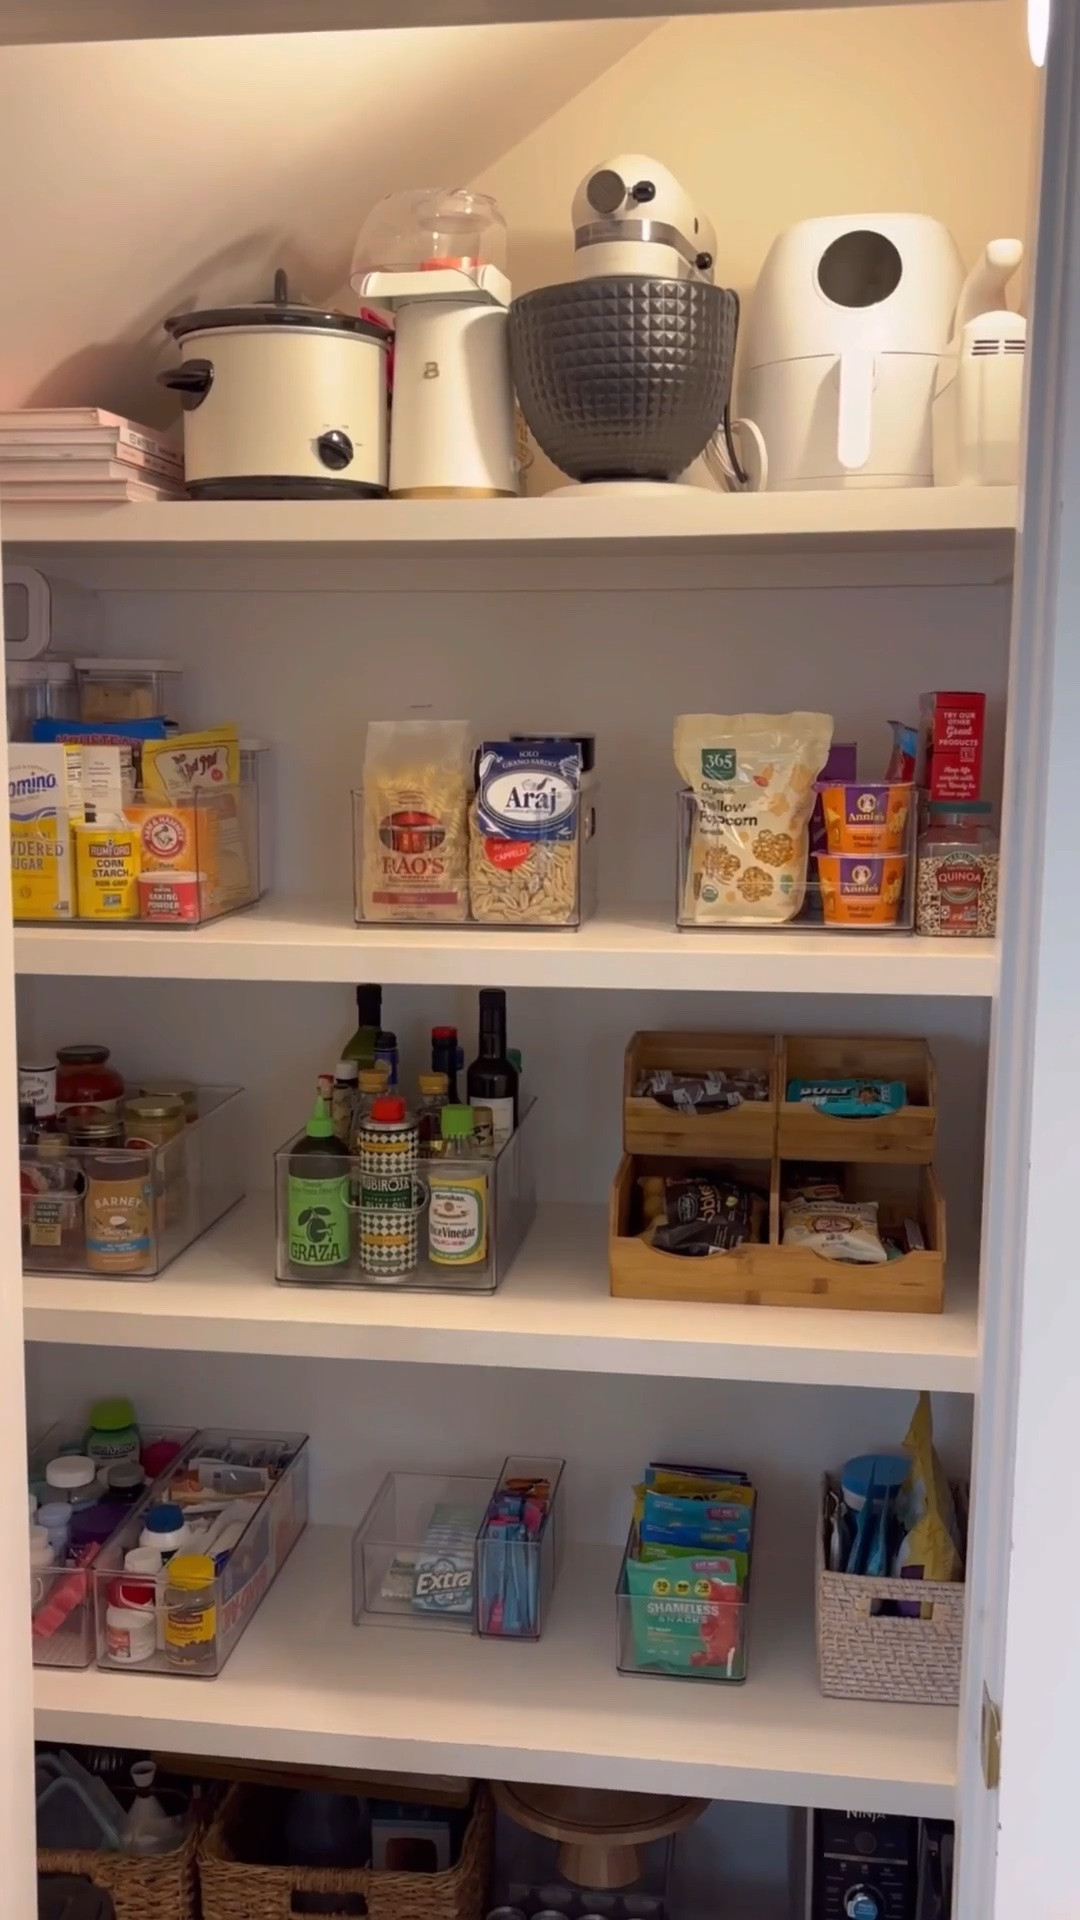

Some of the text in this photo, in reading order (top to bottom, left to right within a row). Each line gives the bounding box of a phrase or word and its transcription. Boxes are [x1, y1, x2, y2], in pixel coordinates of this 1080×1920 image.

[518, 750, 540, 758] SOLO
[705, 753, 733, 769] 365
[502, 758, 530, 769] GRANO
[8, 771, 57, 798] omino
[701, 782, 736, 796] Organic
[505, 786, 557, 816] Araj
[700, 799, 747, 813] Yellow
[699, 810, 758, 827] Popcorn
[11, 840, 64, 857] DERED
[12, 857, 45, 871] UGAR
[96, 859, 124, 868] CORN
[382, 856, 445, 875] RAO'S
[92, 869, 130, 878] STARCH
[938, 871, 982, 883] QUINOA
[94, 1196, 143, 1209] BARNEY
[442, 1226, 477, 1240] Vinegar
[290, 1241, 342, 1261] GRAZA
[415, 1570, 473, 1596] Extra
[646, 1602, 720, 1617] SHAMELESS
[658, 1615, 709, 1625] SNACKS
